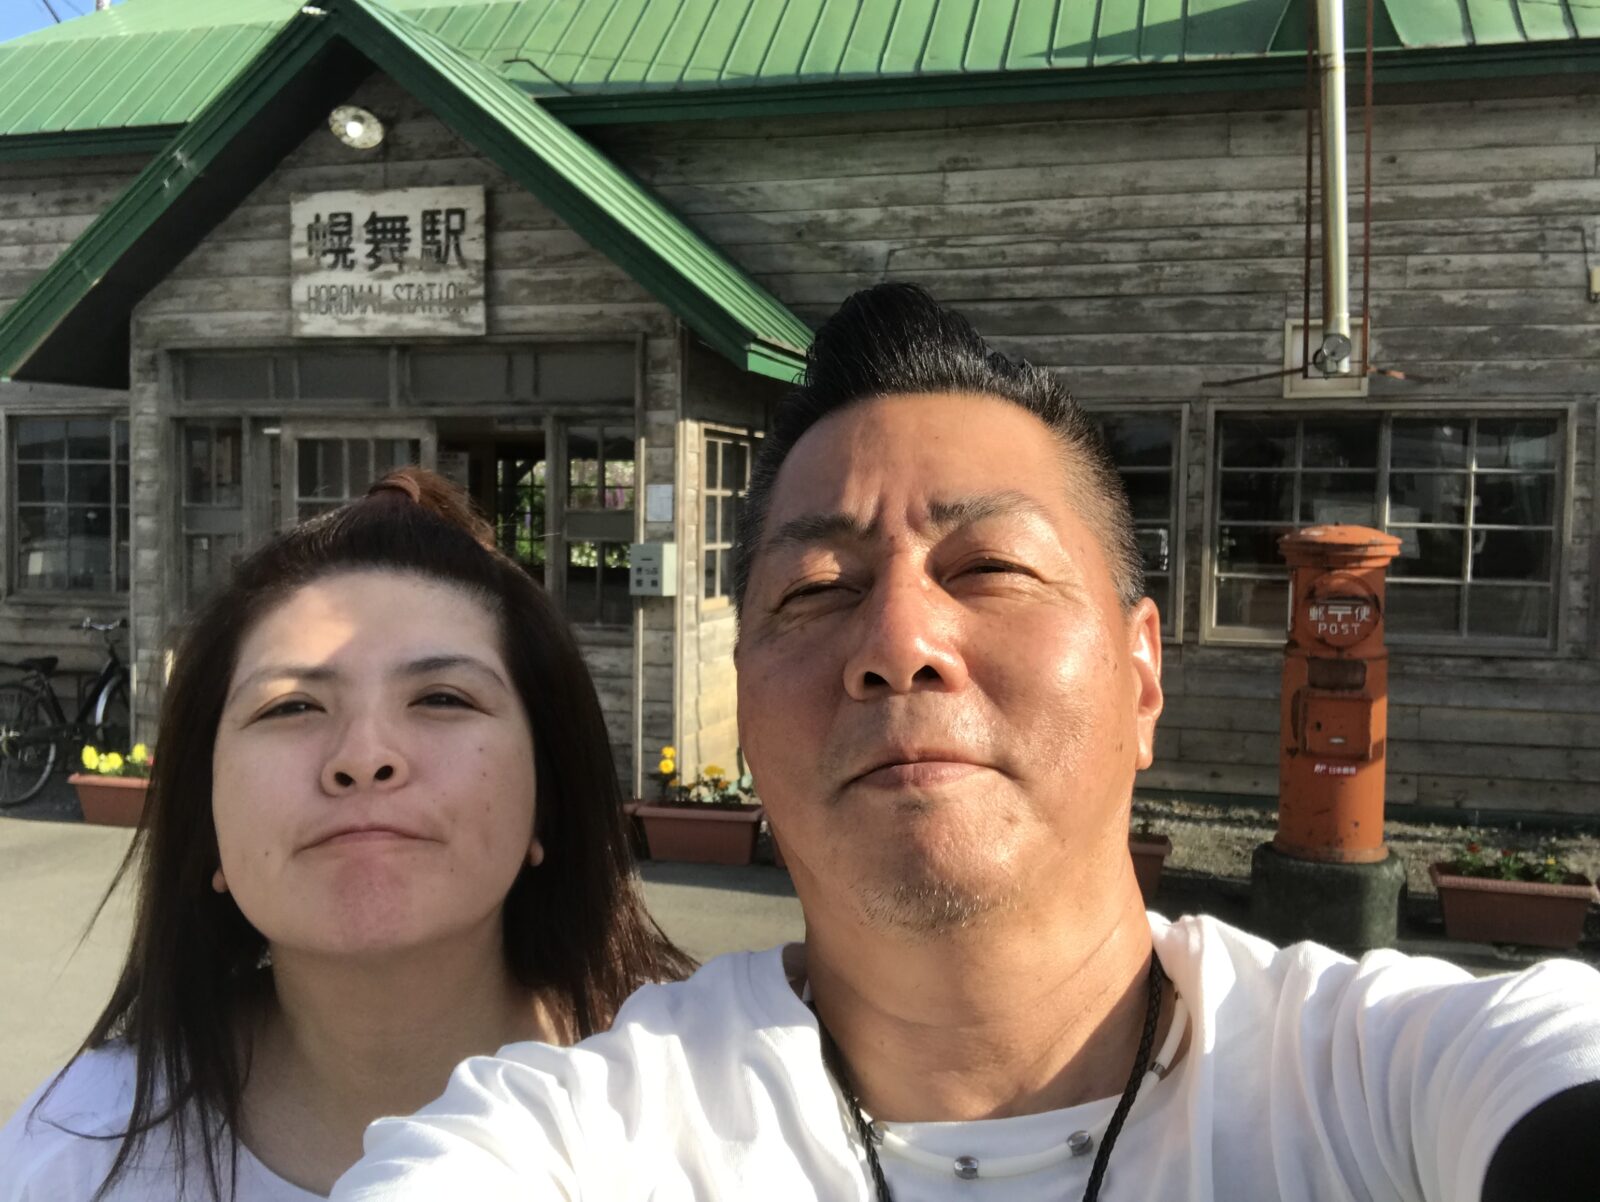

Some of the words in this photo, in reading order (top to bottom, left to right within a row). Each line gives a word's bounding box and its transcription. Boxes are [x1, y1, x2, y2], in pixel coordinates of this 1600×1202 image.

[307, 208, 467, 271] 幌舞駅
[1318, 623, 1360, 635] POST
